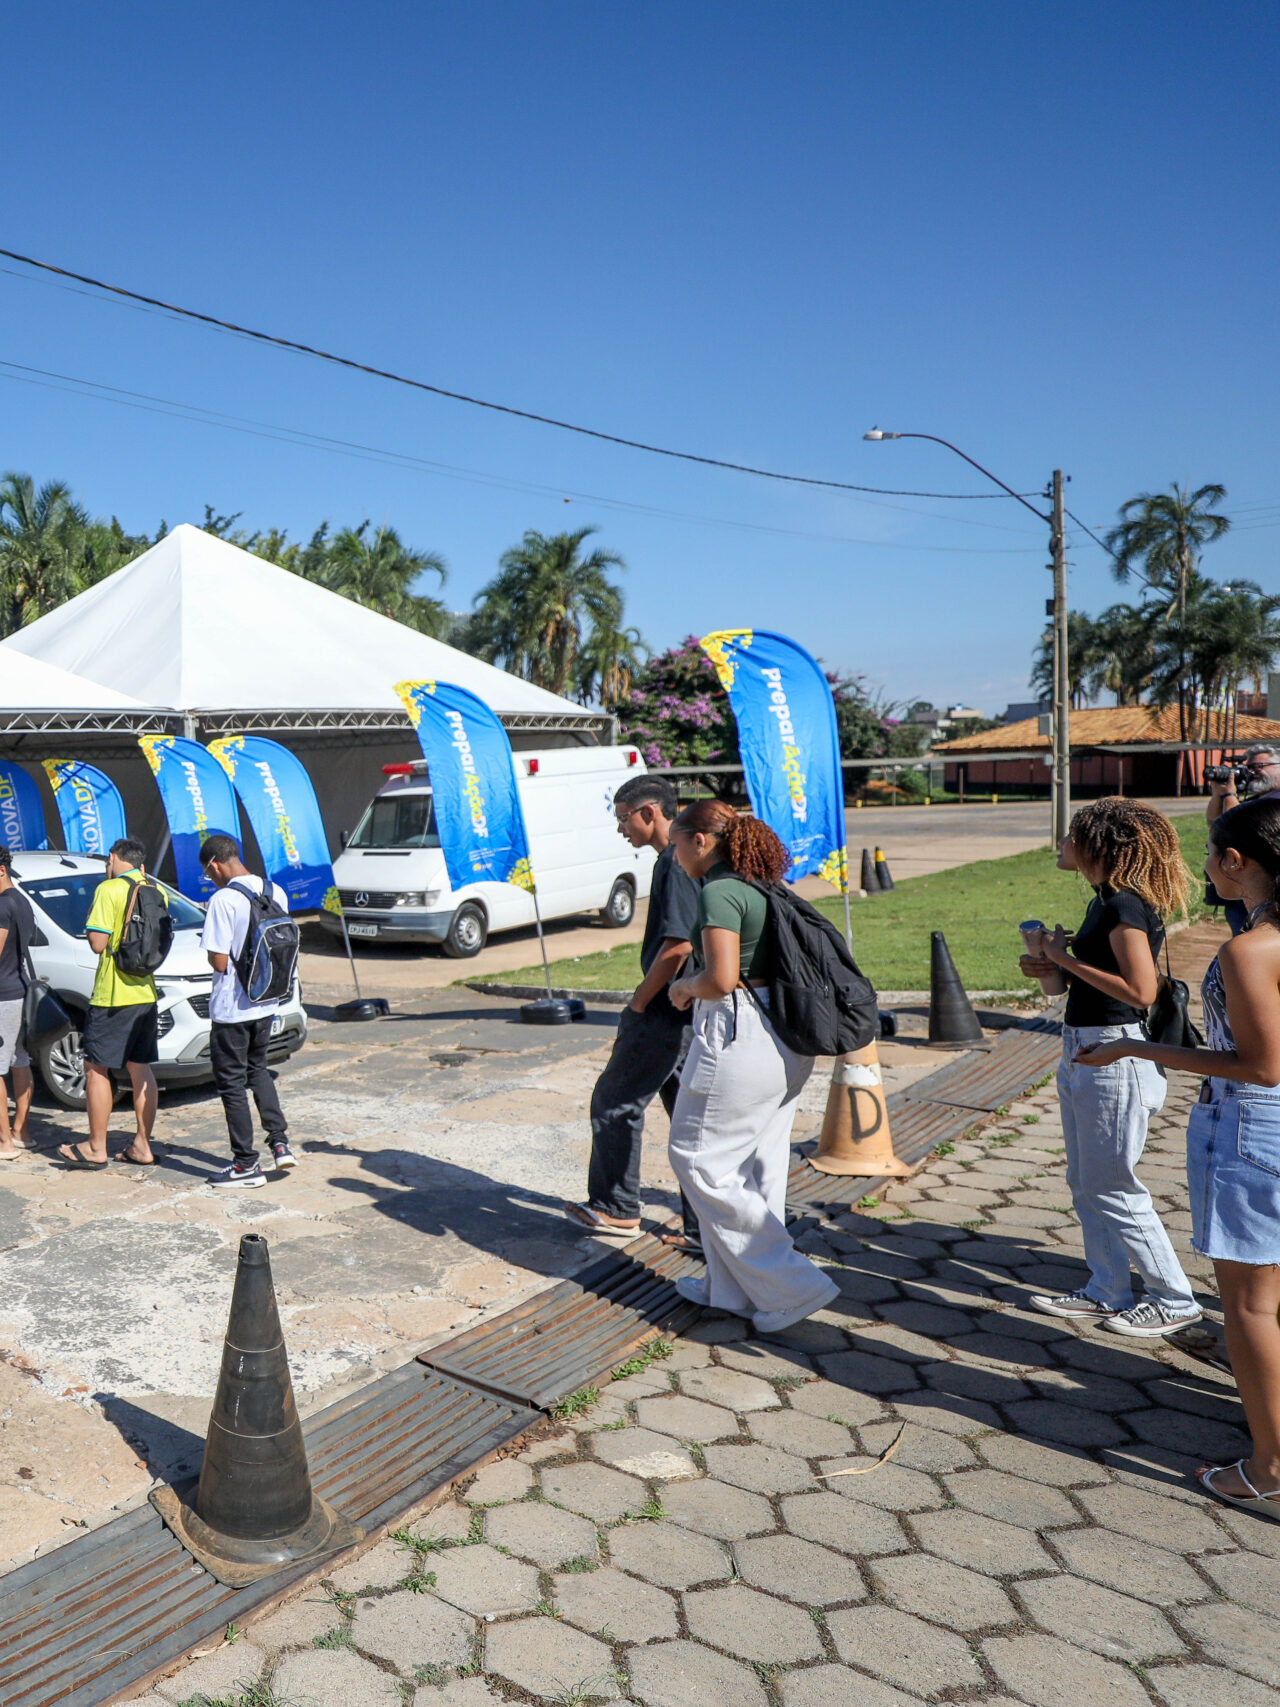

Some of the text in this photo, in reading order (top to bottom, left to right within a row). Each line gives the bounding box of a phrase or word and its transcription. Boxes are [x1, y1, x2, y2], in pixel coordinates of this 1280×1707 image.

[445, 710, 489, 839] PreparAçãoDF
[760, 667, 808, 823] PreparAçãoDF
[70, 776, 100, 854] NOVADF
[181, 761, 212, 847] PreparAçã
[254, 761, 303, 871] PreparAçãoDF
[847, 1086, 883, 1145] D
